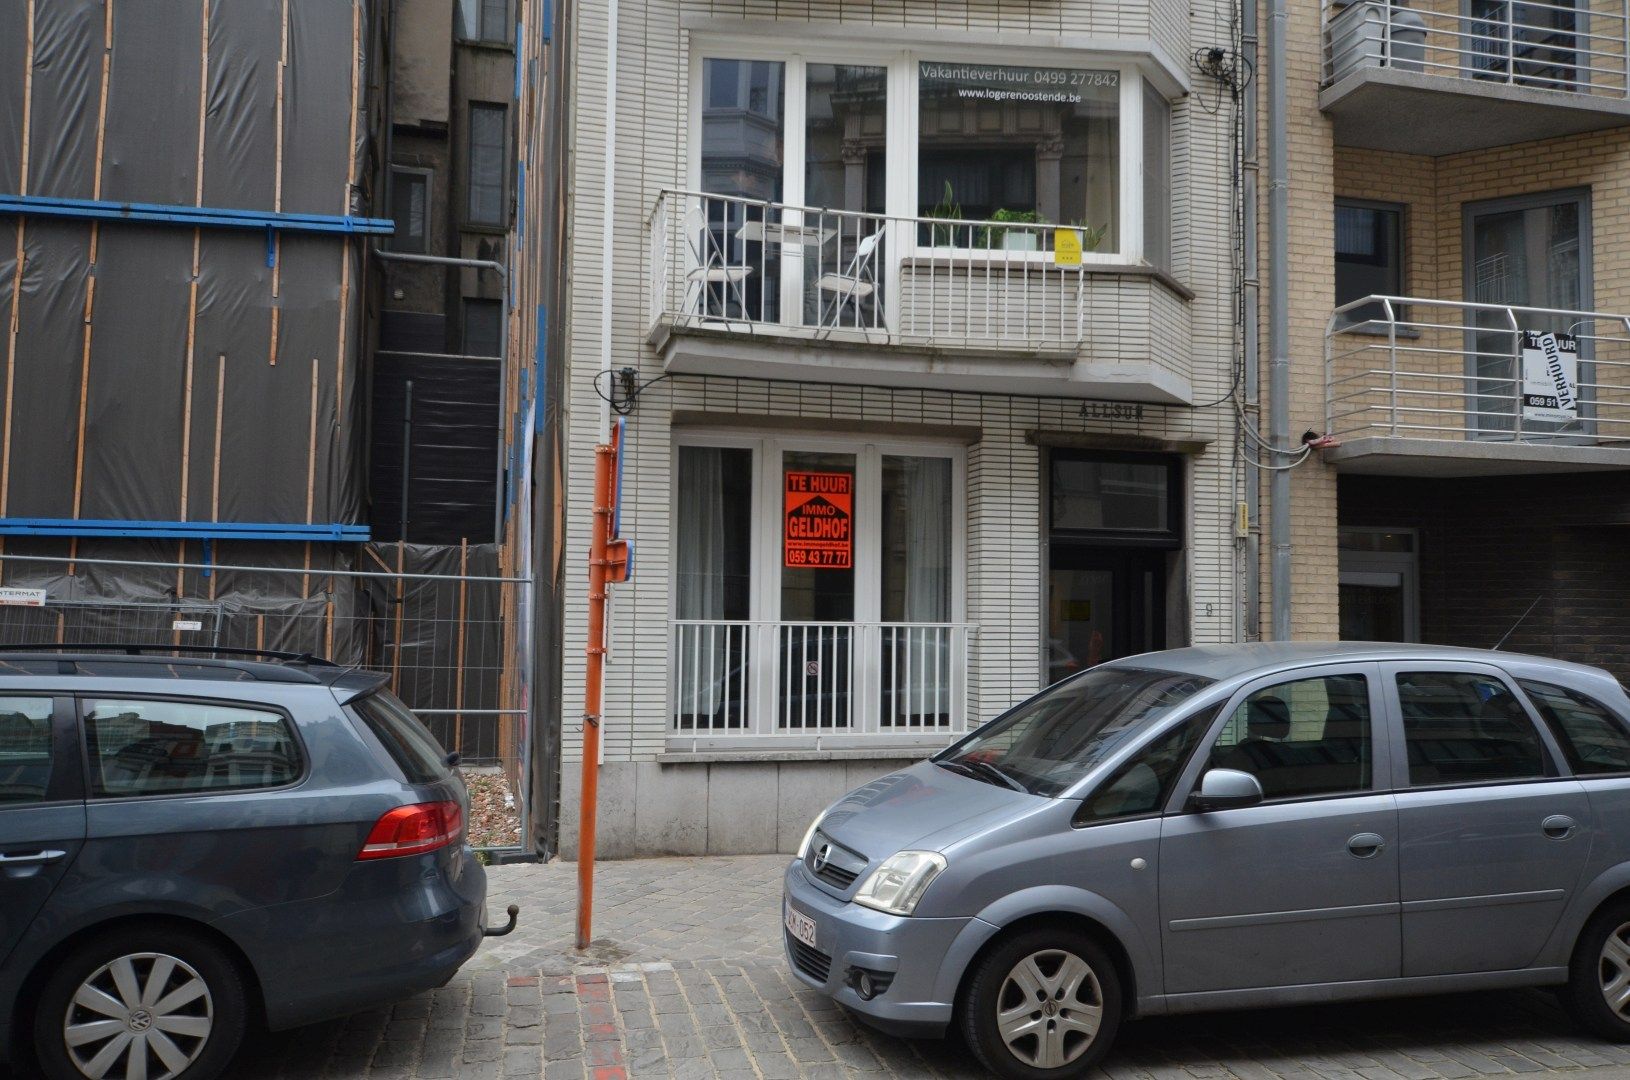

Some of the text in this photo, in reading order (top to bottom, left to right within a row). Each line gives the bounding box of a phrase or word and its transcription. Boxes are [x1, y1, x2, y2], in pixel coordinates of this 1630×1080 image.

[921, 65, 1118, 87] Vakantieverhuur 0499 277842
[958, 87, 1081, 103] www.logerenoostende.be
[1543, 337, 1571, 407] VERHUURD
[1530, 397, 1545, 405] 059
[790, 475, 847, 493] TE HUUR
[802, 504, 836, 516] IMMO
[789, 516, 848, 539] GELDHOF
[789, 550, 847, 564] 059 43 77 77
